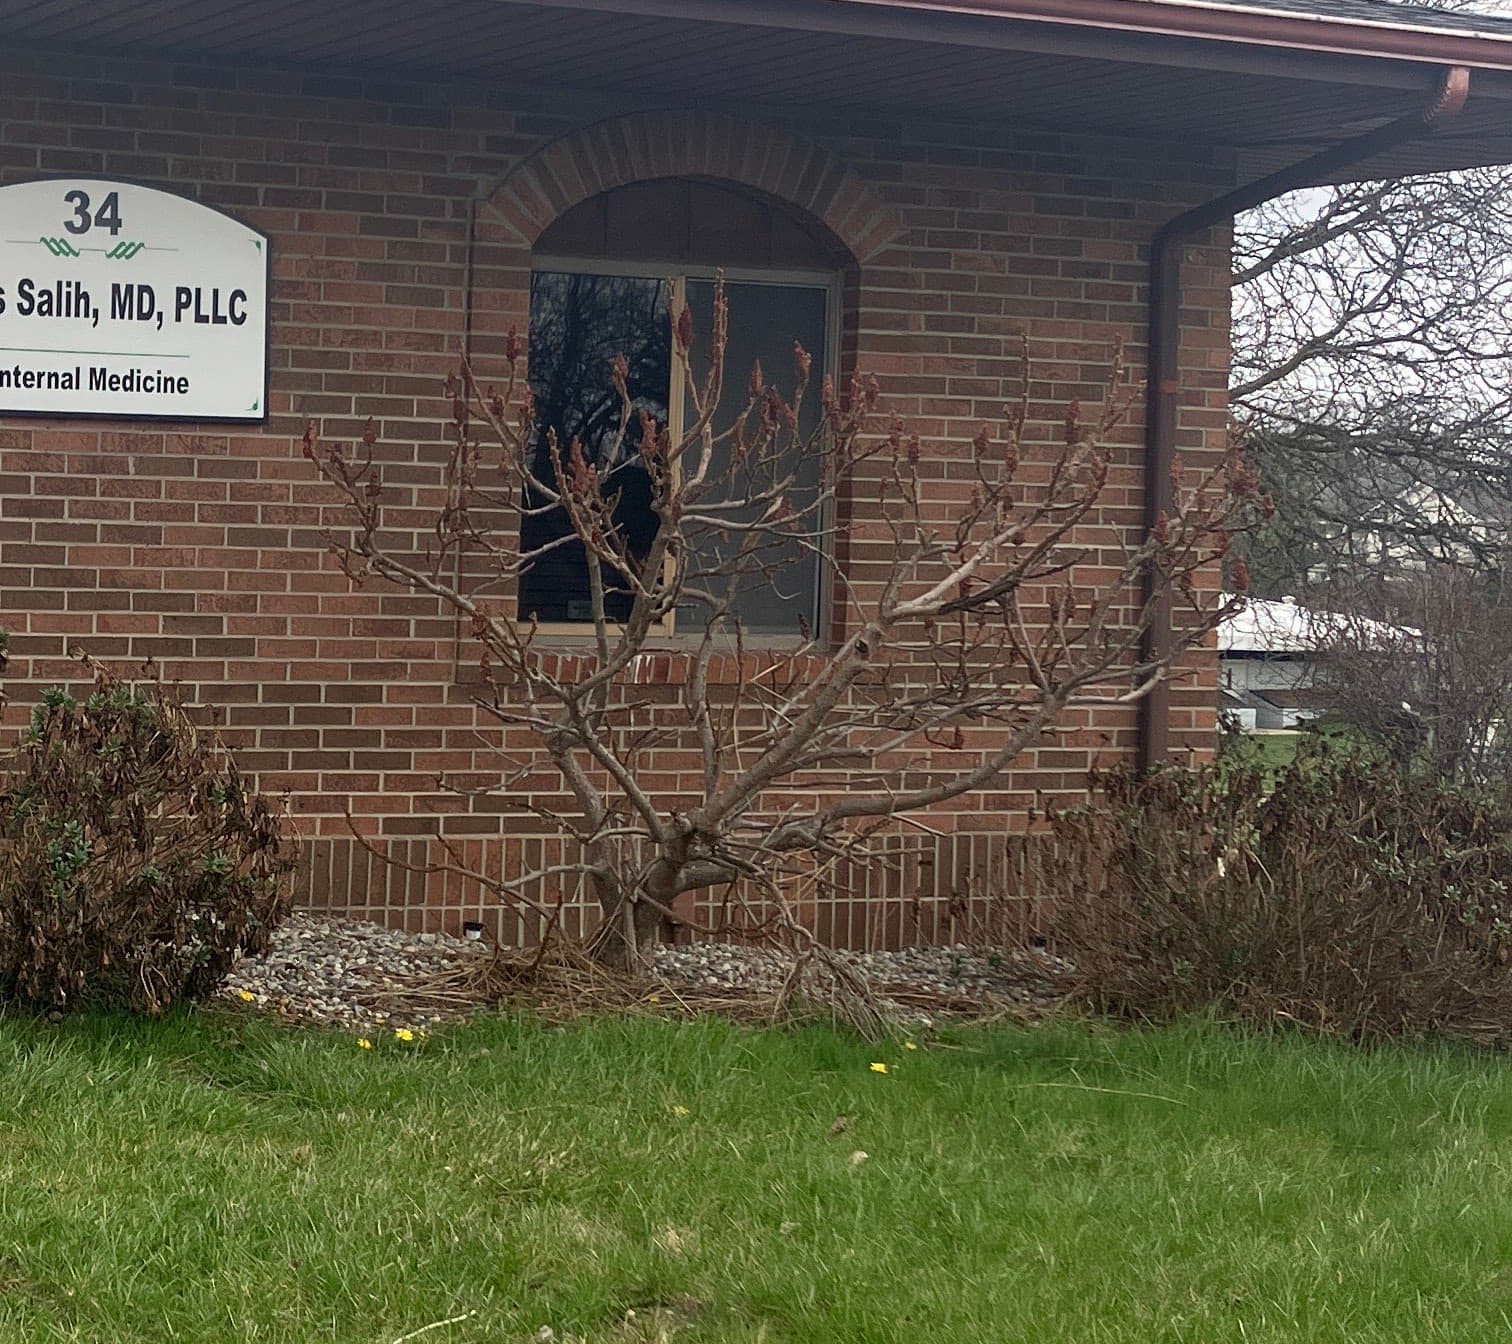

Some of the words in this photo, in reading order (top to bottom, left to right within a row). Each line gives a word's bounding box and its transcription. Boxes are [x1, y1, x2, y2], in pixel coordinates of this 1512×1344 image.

[63, 189, 123, 236] 34
[16, 277, 100, 328] Salih,
[110, 282, 164, 331] MD,
[174, 286, 248, 326] PLLC
[88, 366, 190, 394] Medicine
